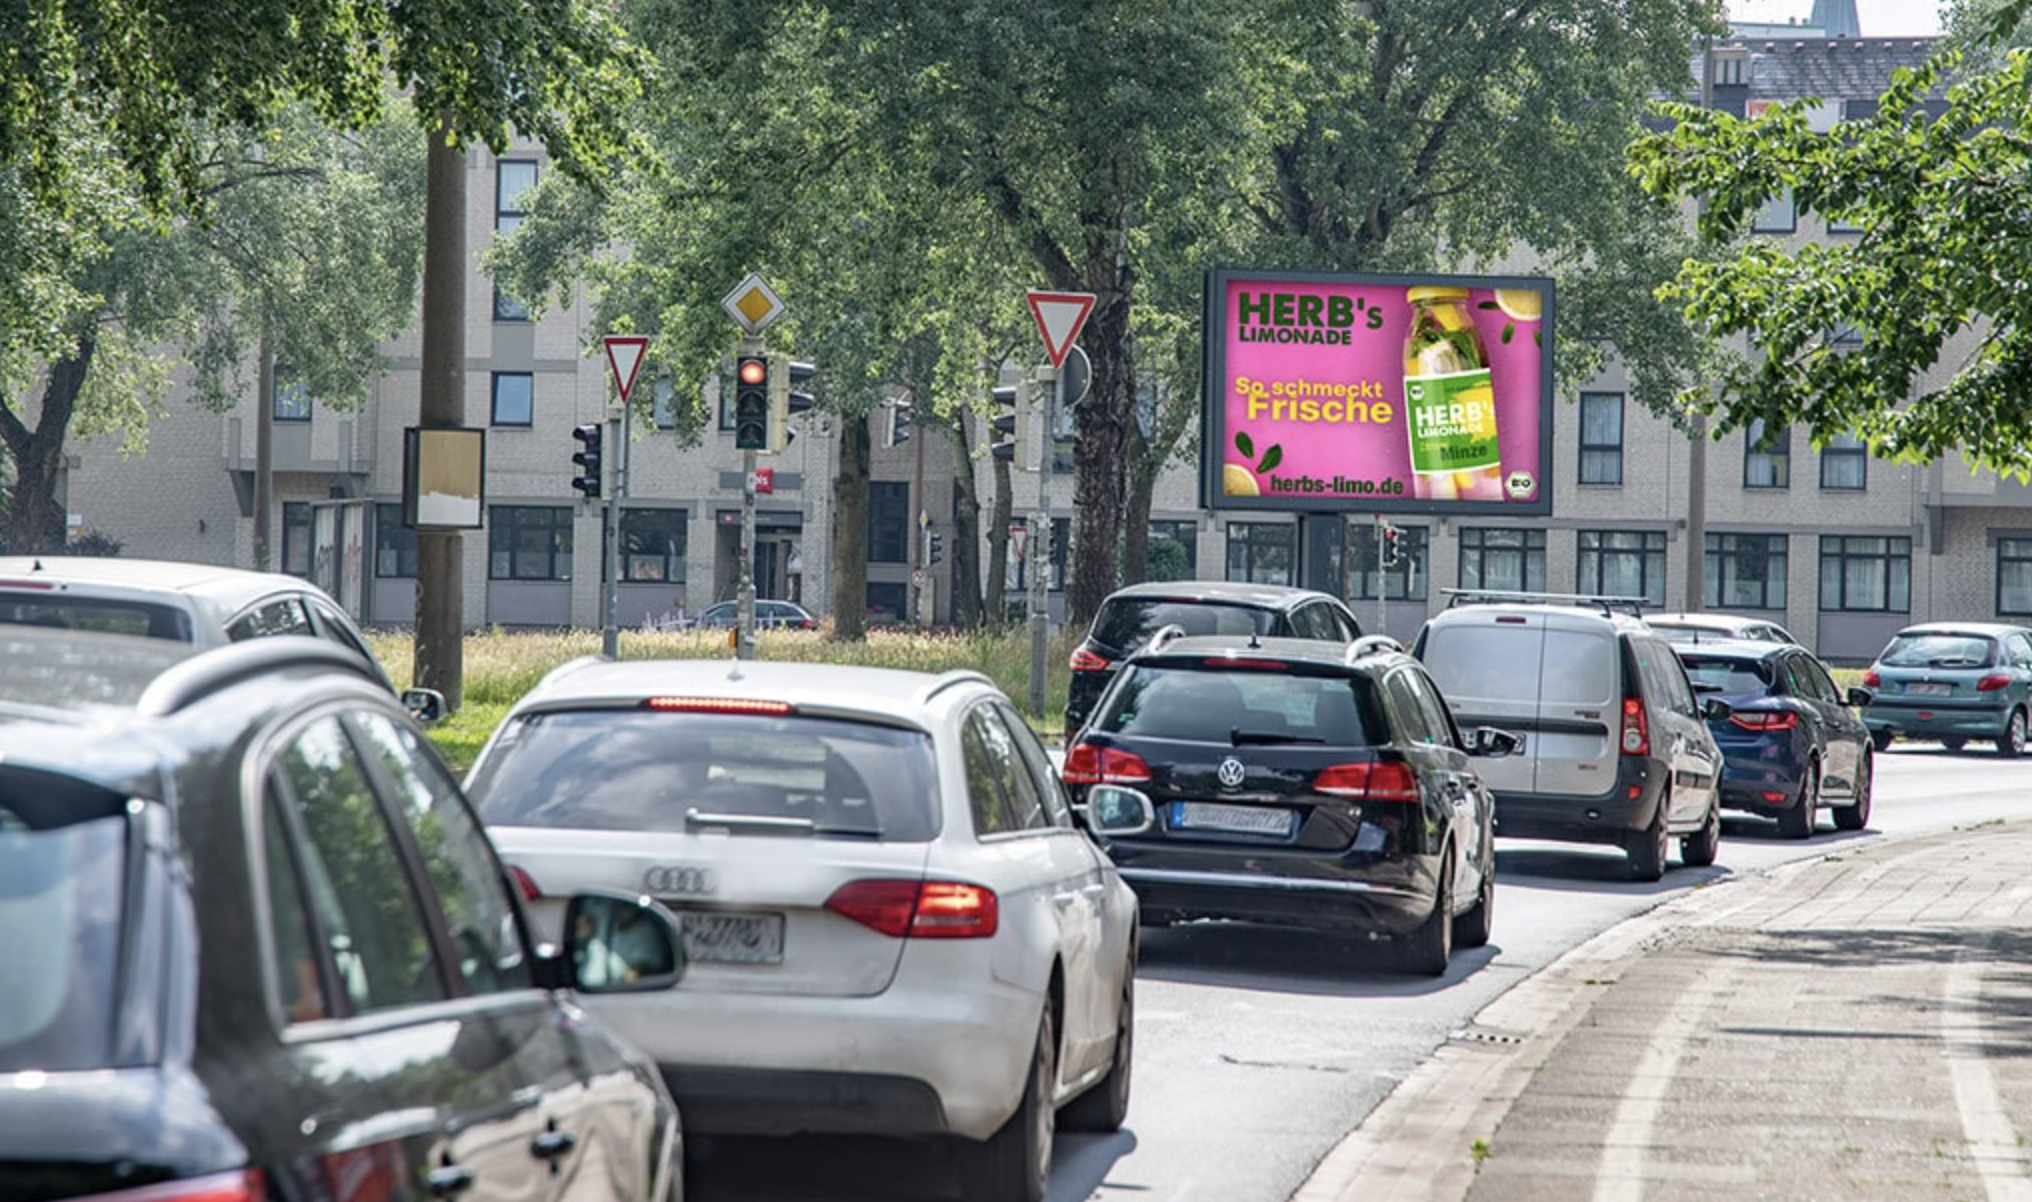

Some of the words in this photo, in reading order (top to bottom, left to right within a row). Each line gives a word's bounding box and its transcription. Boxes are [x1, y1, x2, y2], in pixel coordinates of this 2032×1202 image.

[1238, 292, 1384, 330] HERB's
[1239, 326, 1352, 345] LIMONADE
[1235, 377, 1264, 395] So
[1271, 378, 1383, 398] schmeckt
[1247, 392, 1394, 424] Frische
[1441, 446, 1487, 461] Minze
[1270, 475, 1403, 494] herbs-limo.de
